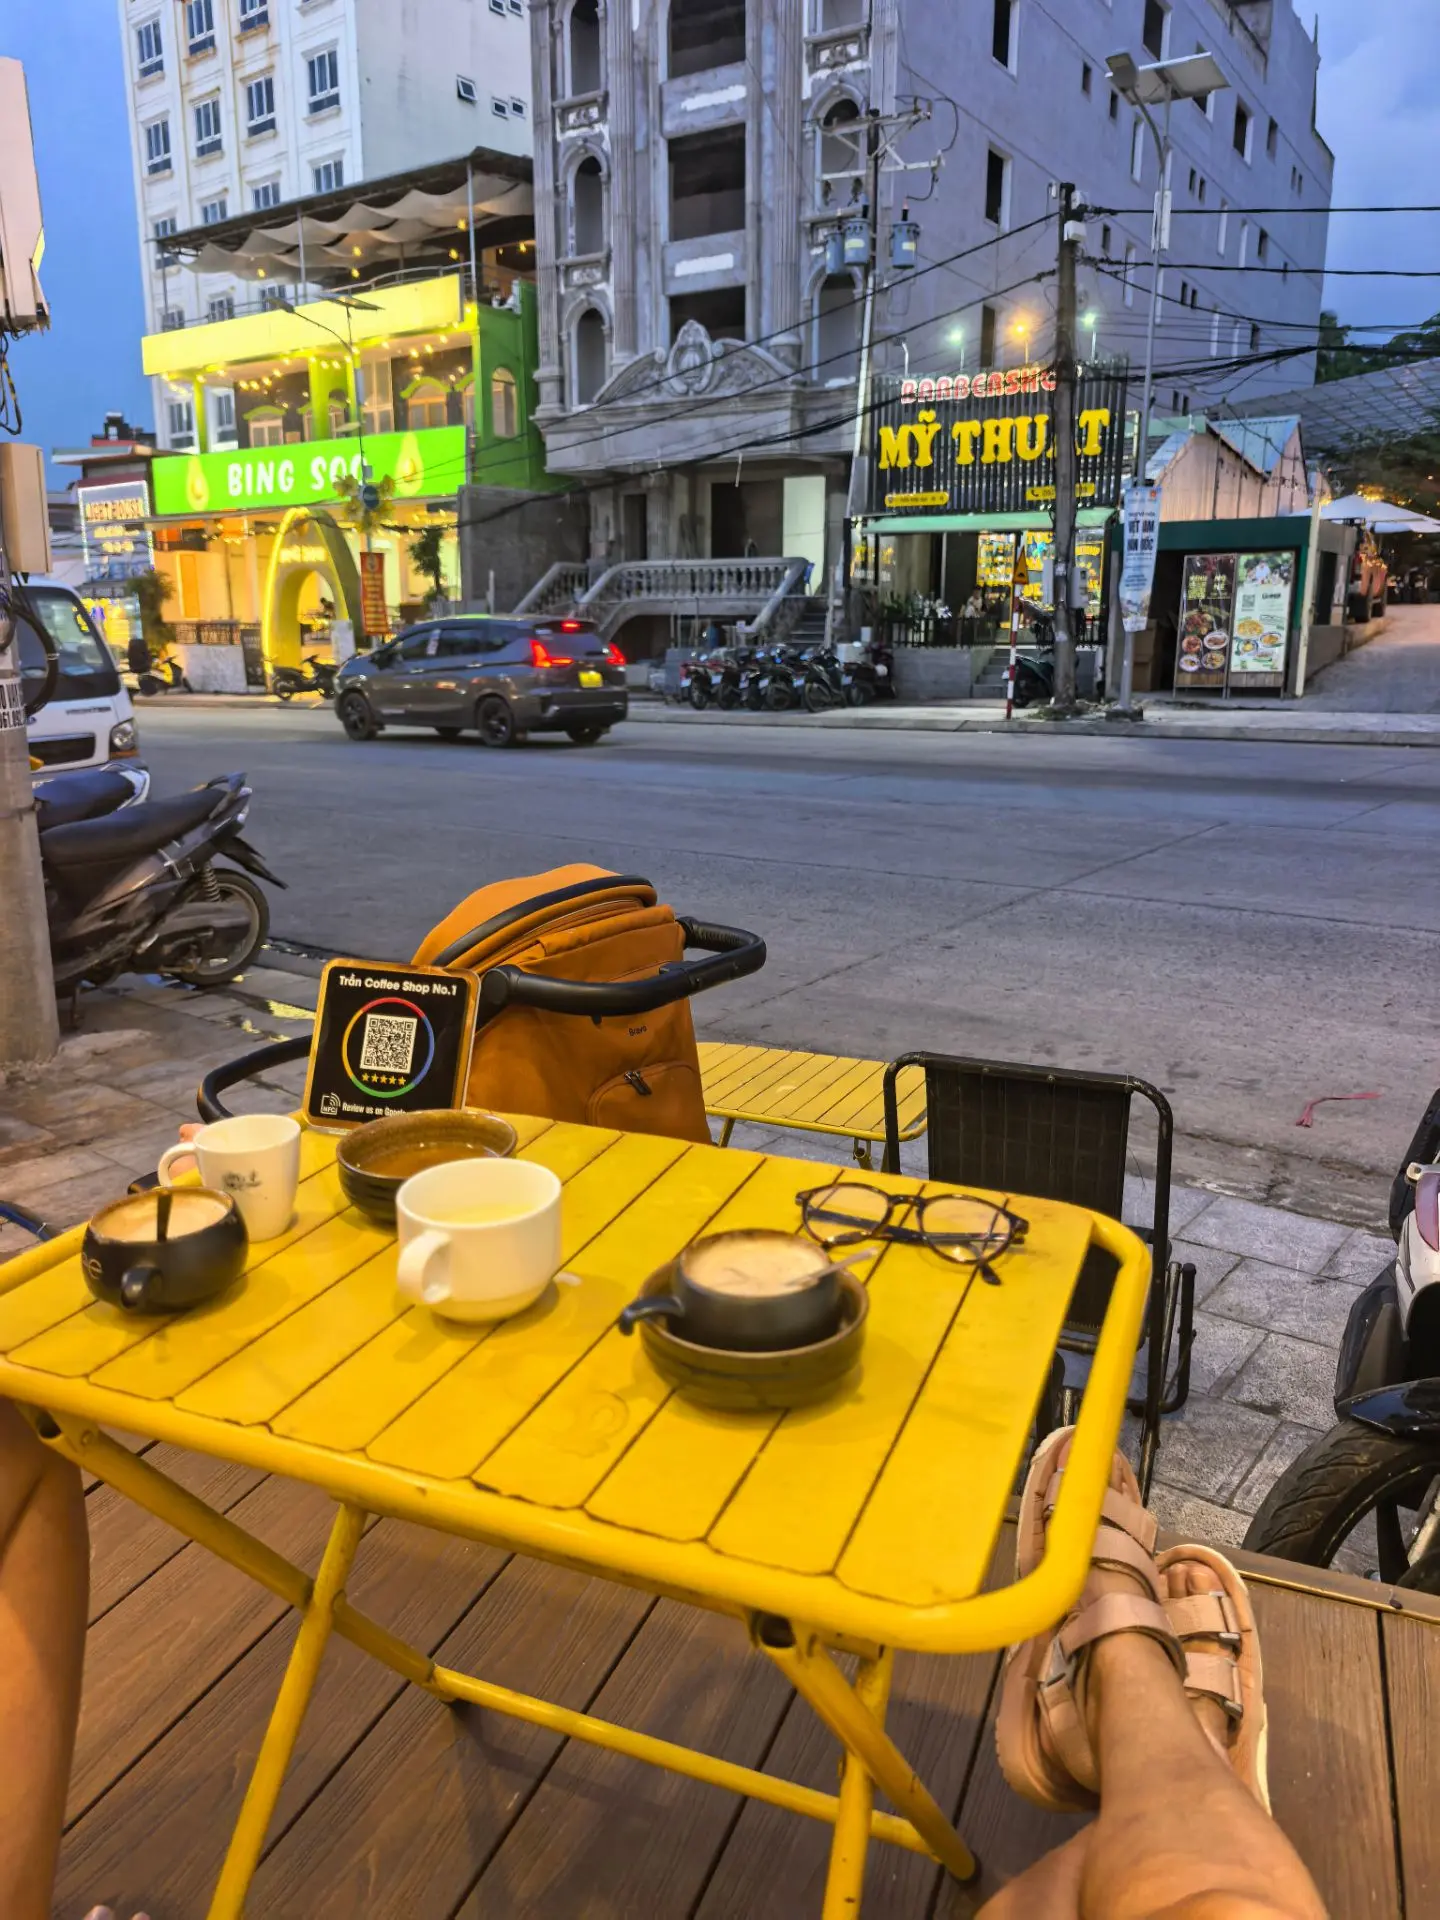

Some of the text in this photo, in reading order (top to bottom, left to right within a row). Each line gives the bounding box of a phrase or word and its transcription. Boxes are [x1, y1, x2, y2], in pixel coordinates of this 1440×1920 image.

[878, 408, 1111, 470] MỸ THUT
[227, 459, 295, 497] BING
[364, 977, 400, 991] Coffee
[402, 980, 430, 995] Shop
[432, 984, 457, 996] No.1
[342, 1102, 364, 1113] Review
[365, 1105, 374, 1114] us
[375, 1107, 383, 1115] on
